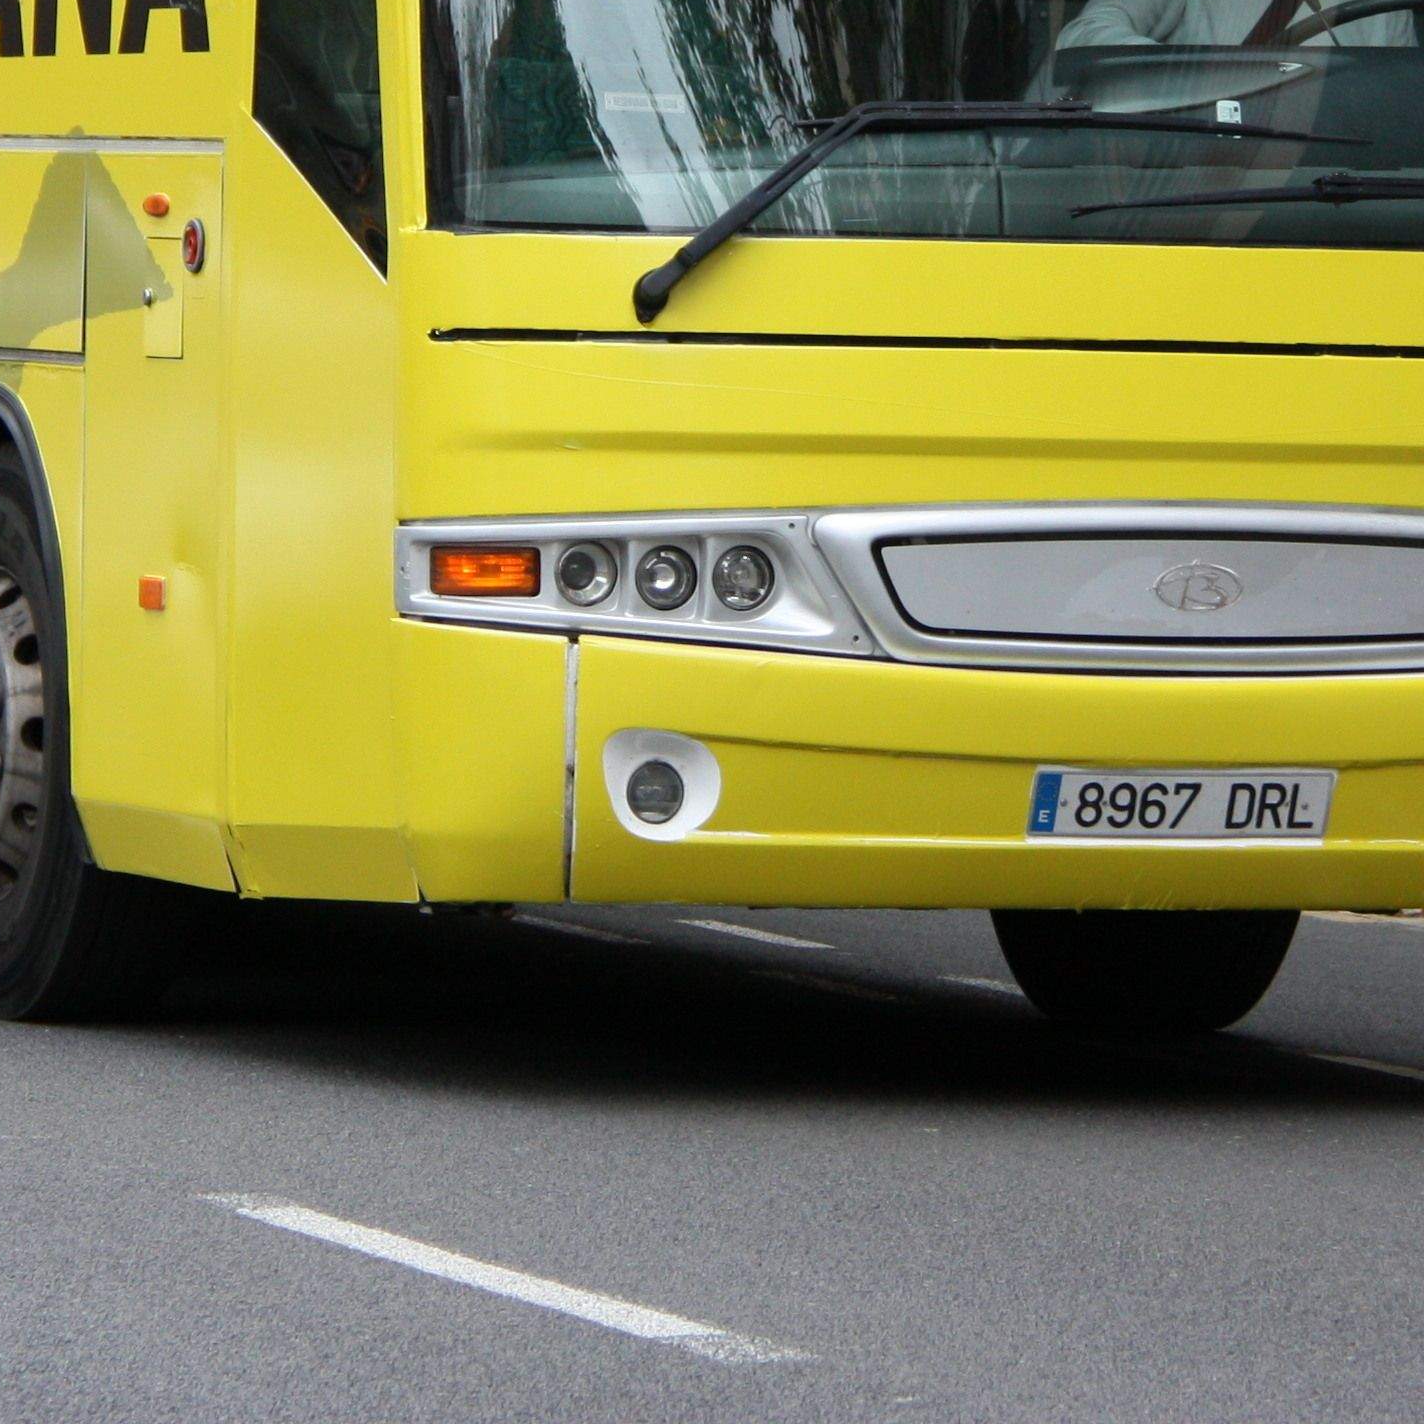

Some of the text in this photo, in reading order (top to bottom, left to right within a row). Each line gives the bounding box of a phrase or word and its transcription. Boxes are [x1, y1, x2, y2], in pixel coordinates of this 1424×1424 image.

[1037, 809, 1050, 823] E
[1074, 781, 1314, 829] 8967 DRL
